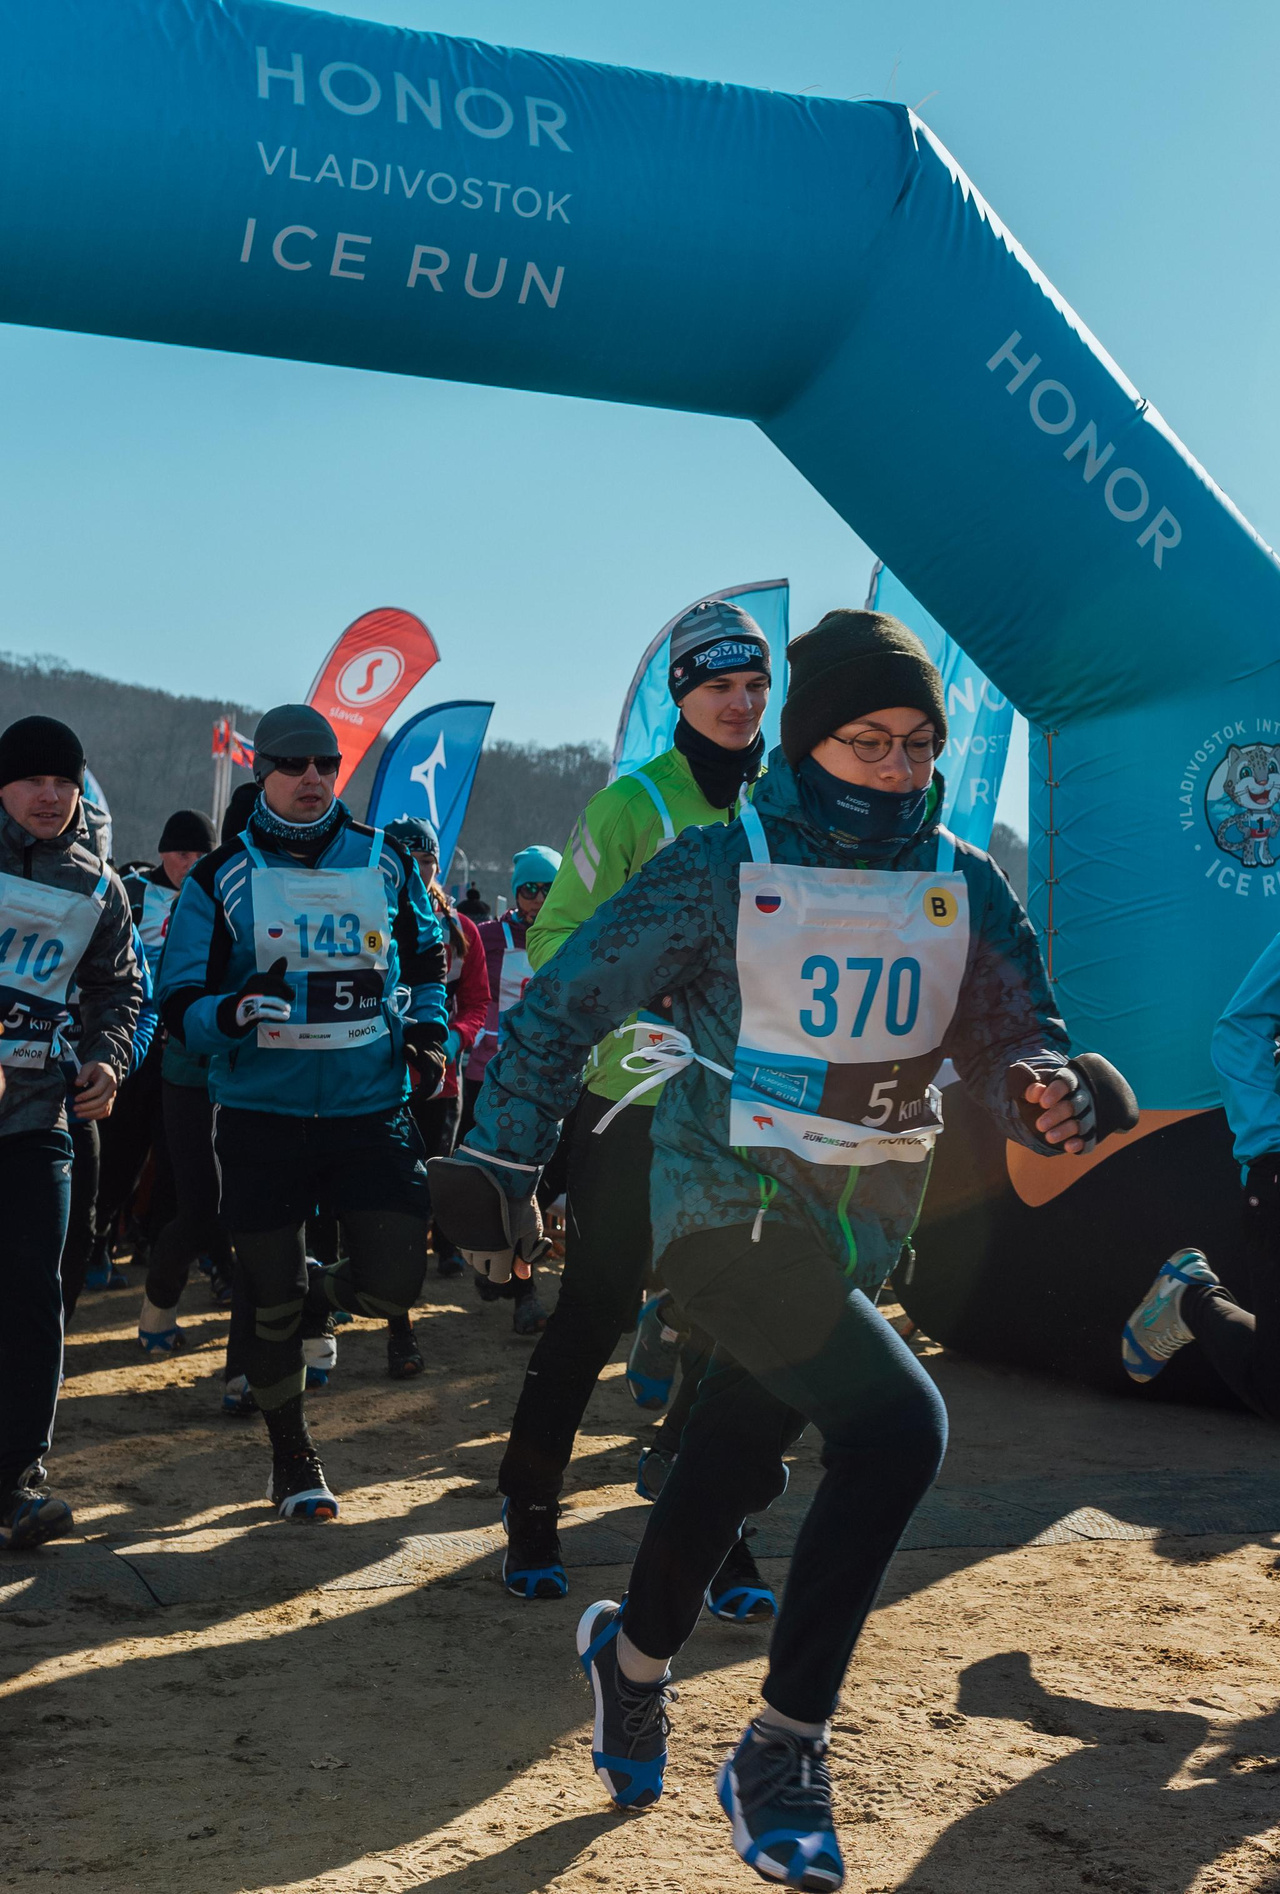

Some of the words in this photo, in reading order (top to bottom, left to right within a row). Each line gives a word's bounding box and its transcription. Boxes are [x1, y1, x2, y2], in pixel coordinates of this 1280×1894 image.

[256, 46, 574, 153] HONOR
[257, 141, 573, 224] VLADIVOSTOK
[240, 218, 372, 281] ICE
[406, 244, 565, 309] RUN
[985, 329, 1182, 570] HONOR
[696, 645, 762, 664] DOMINA
[329, 706, 364, 726] slavda
[1179, 720, 1247, 831] VLADIVOSTOK
[1205, 859, 1252, 897] ICE
[931, 896, 947, 918] B
[0, 927, 64, 983] 410
[294, 913, 361, 958] 143
[368, 936, 376, 948] B
[3, 1002, 31, 1029] 5
[29, 1019, 52, 1031] km
[333, 981, 354, 1011] 5
[359, 995, 377, 1009] km
[799, 954, 921, 1038] 370
[348, 1025, 377, 1039] HONOR
[13, 1047, 43, 1059] HONOR
[860, 1080, 899, 1128] 5
[898, 1098, 922, 1122] km
